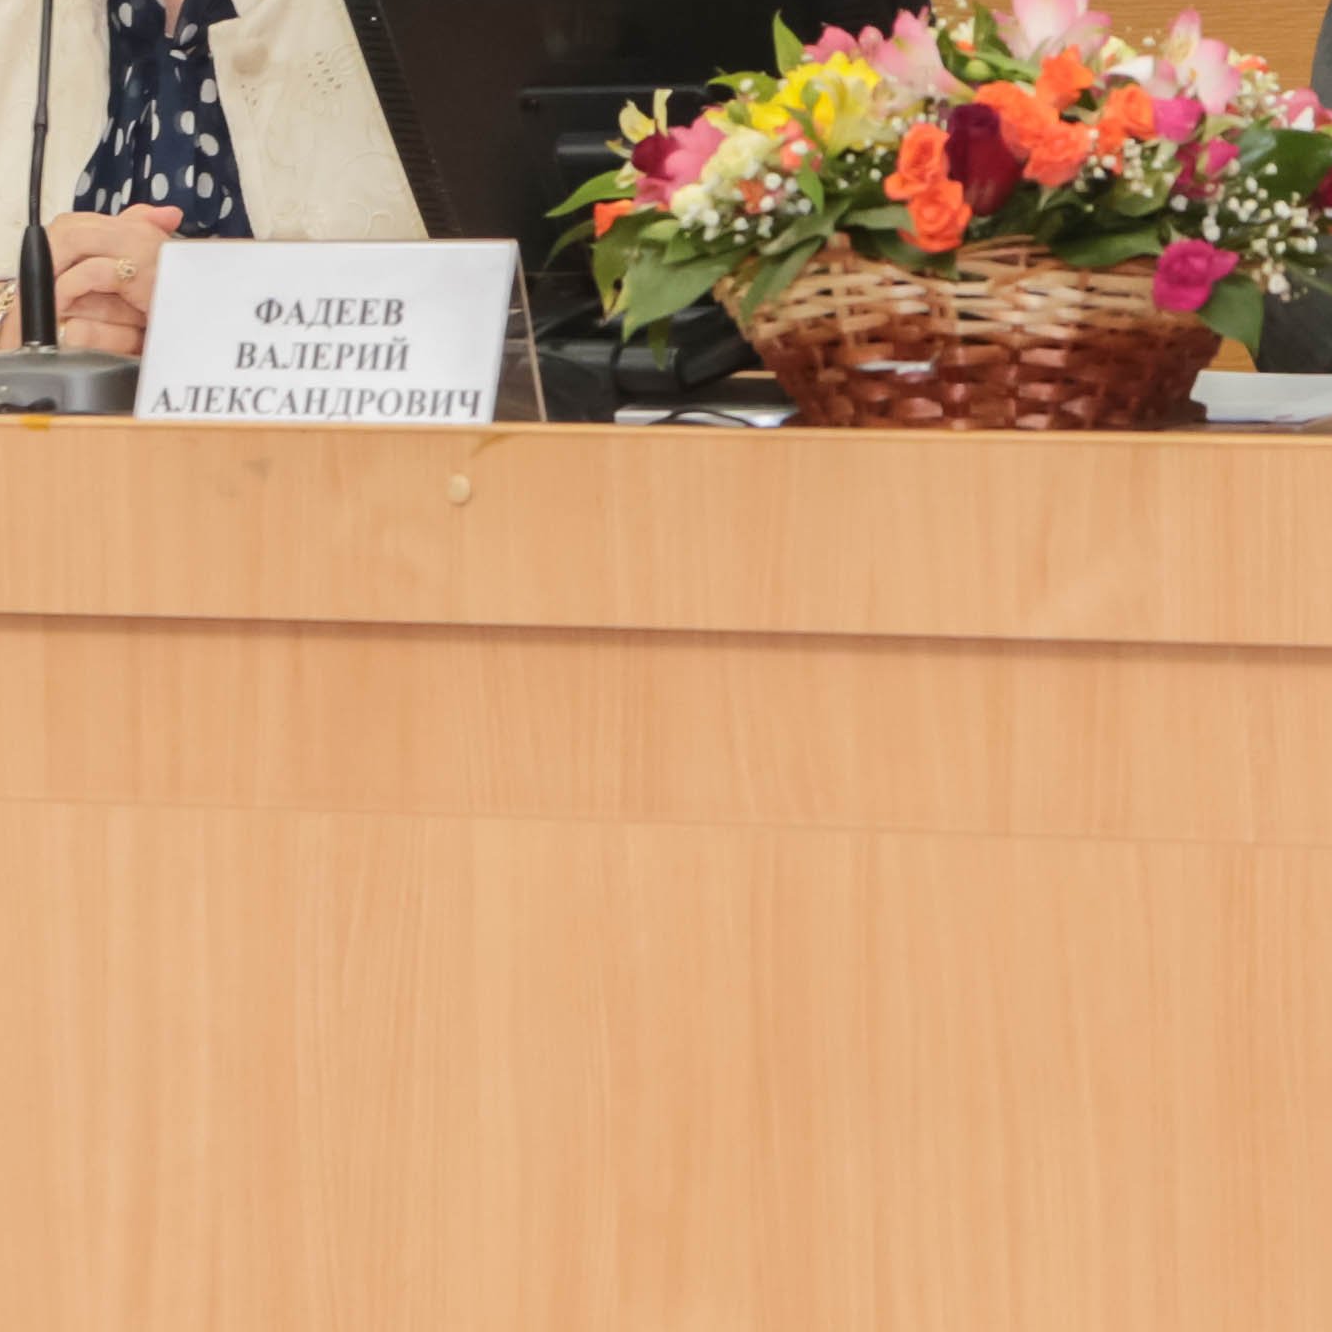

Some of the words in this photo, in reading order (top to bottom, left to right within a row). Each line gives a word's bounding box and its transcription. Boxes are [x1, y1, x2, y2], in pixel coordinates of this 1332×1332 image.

[254, 297, 404, 328] ФАДЕЕВ
[234, 336, 410, 372] ВАЛЕРИЙ
[150, 385, 483, 421] АЛЕКСАНДРОВИЧ
